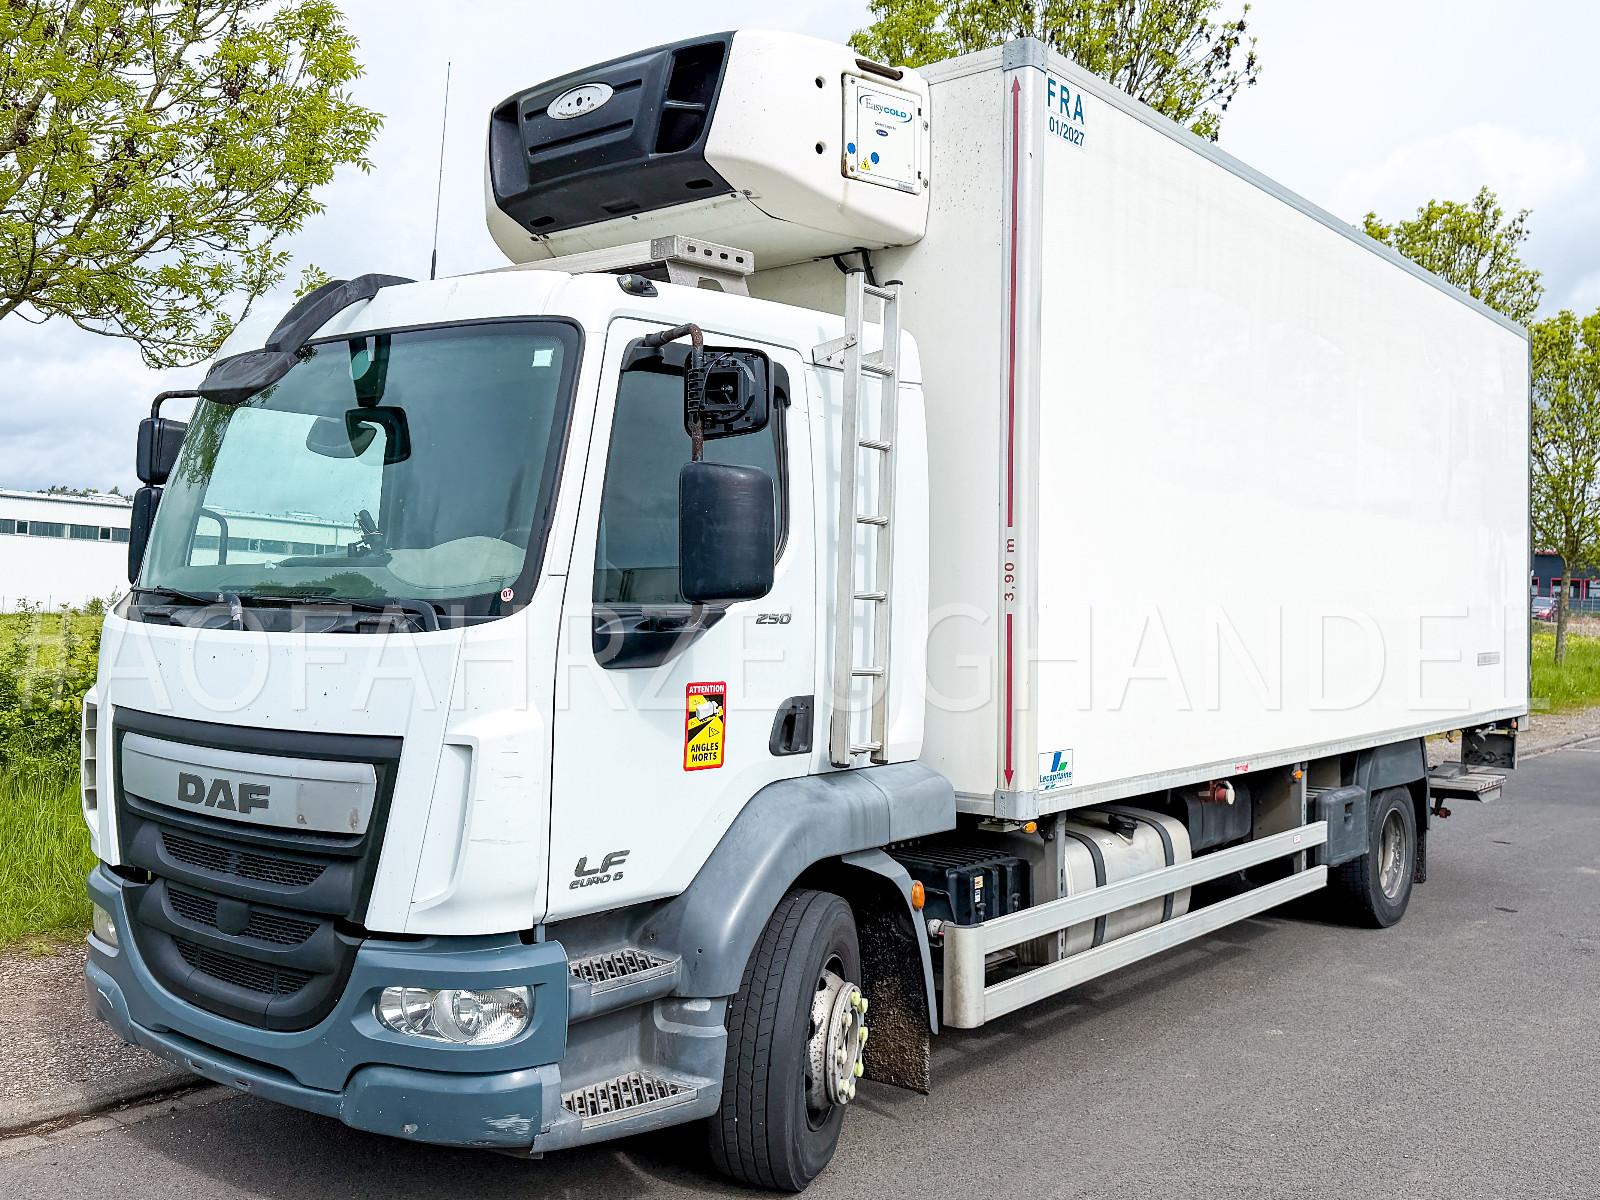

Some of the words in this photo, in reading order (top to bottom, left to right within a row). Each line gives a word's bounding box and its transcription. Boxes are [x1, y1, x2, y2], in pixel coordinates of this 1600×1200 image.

[1047, 77, 1085, 125] FRA
[1049, 116, 1085, 147] 01/2027
[1006, 538, 1015, 553] m
[1004, 562, 1017, 602] 3,90
[755, 613, 792, 625] 250
[688, 684, 725, 694] ATTENTION
[690, 742, 719, 753] ANGLES
[691, 751, 717, 763] MORTS
[178, 771, 271, 814] DAF
[574, 849, 631, 878] LF
